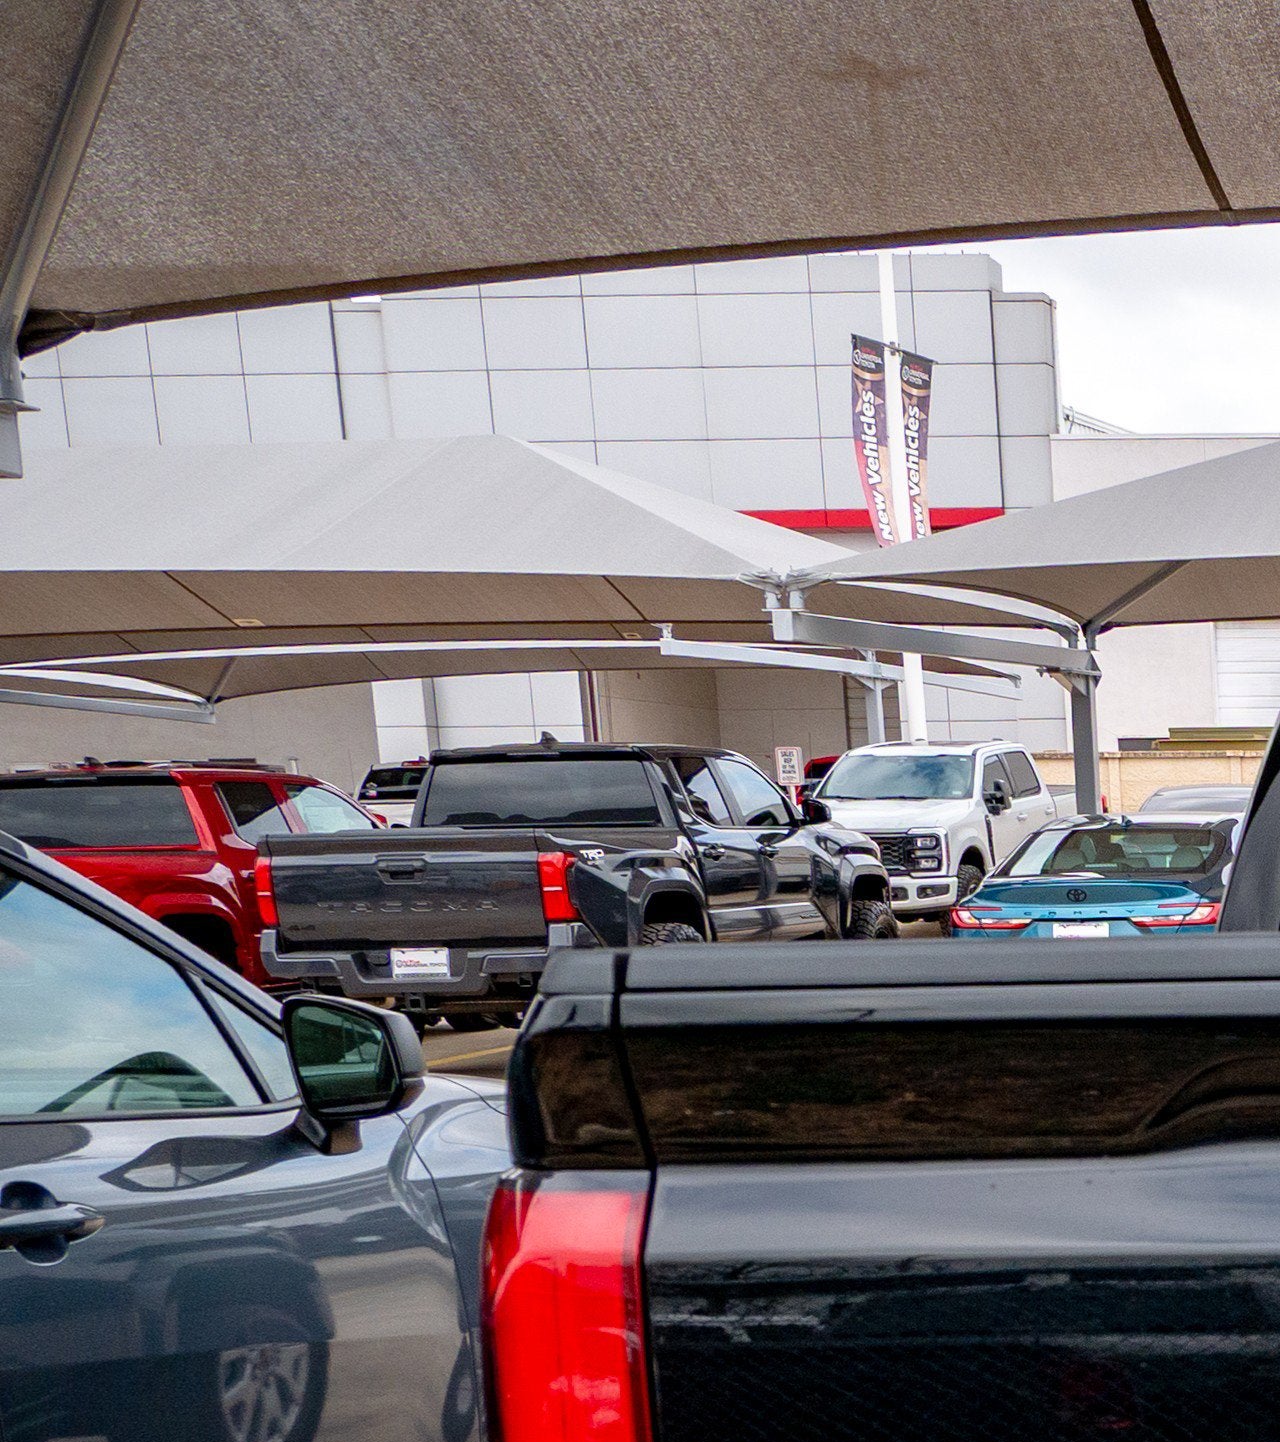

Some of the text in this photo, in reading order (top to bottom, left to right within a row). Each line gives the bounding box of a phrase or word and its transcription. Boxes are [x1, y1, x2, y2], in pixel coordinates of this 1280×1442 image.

[860, 390, 882, 486] Vehicles
[905, 405, 921, 496] Vehicles
[872, 488, 894, 541] New
[579, 849, 605, 860] TRD
[316, 900, 500, 915] TACOMA
[1023, 909, 1136, 917] CAMRY
